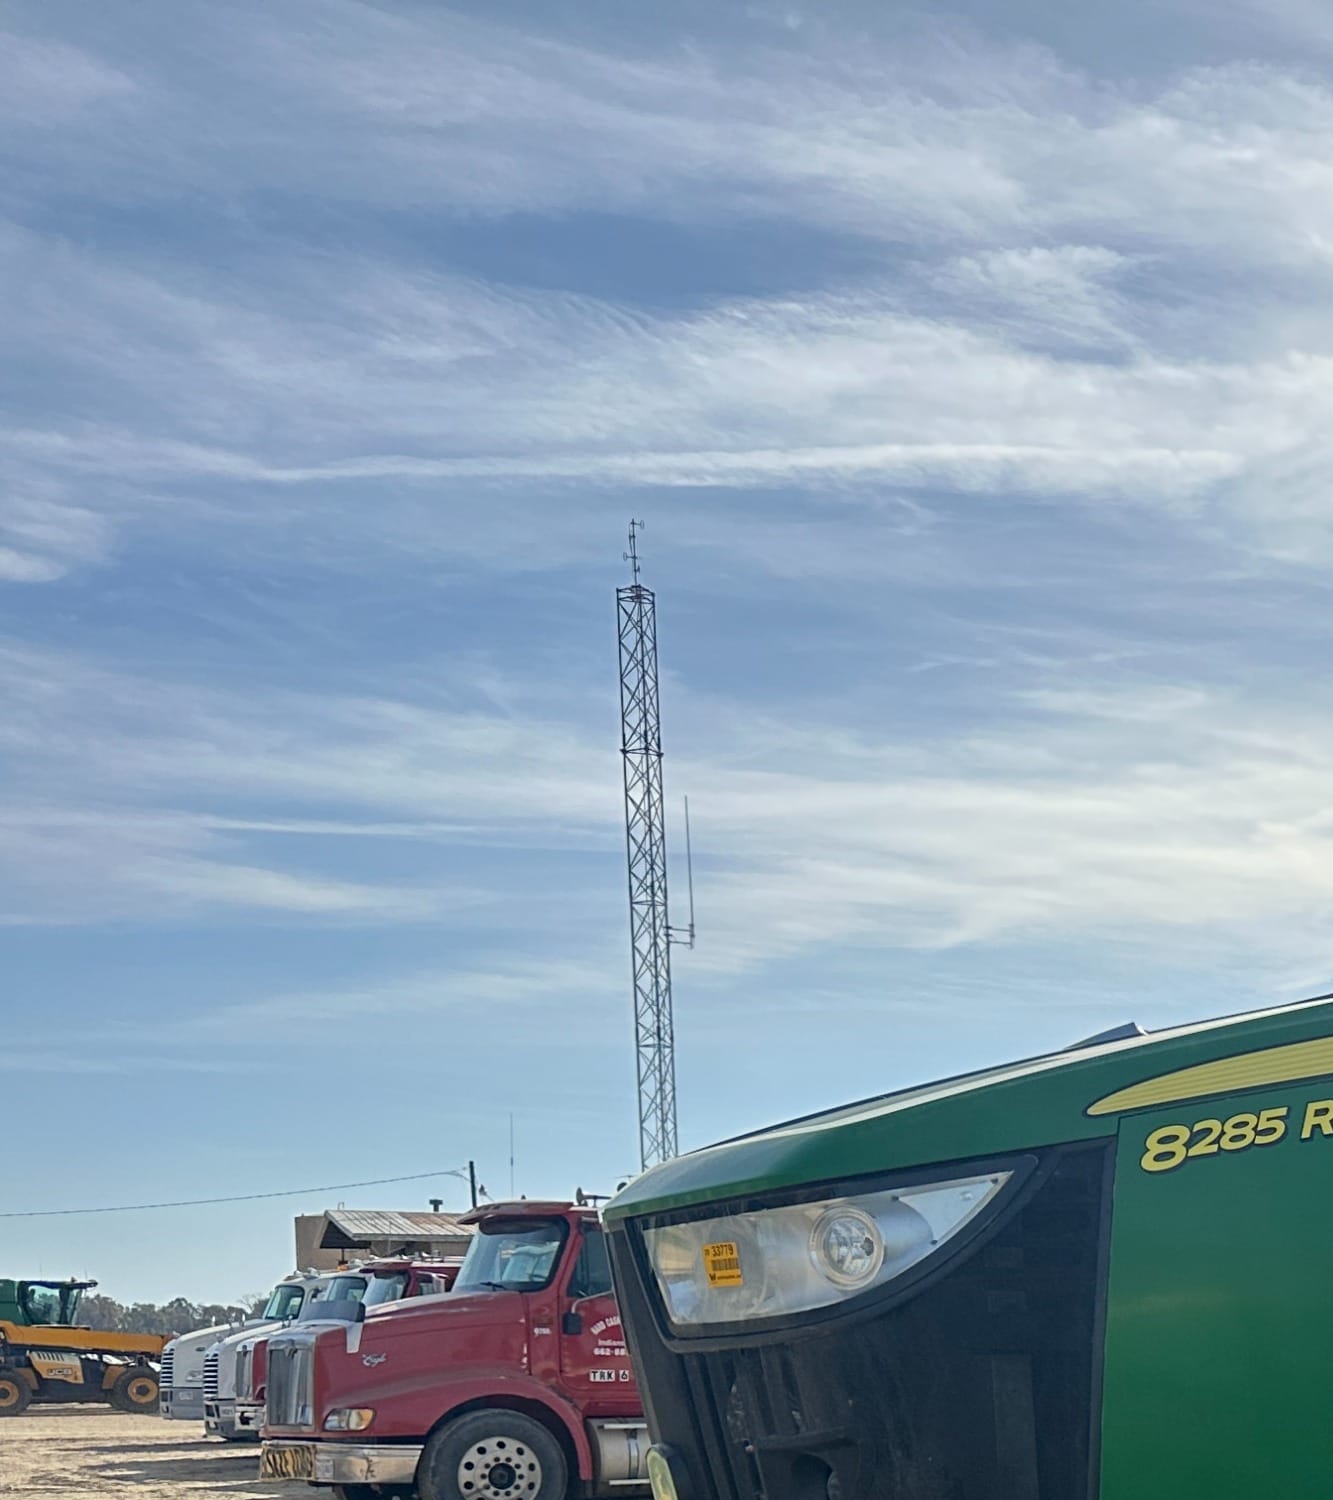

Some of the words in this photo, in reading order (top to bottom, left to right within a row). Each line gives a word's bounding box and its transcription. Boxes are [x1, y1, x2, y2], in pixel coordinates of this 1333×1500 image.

[1140, 1106, 1288, 1173] 8285
[591, 1371, 614, 1380] TRK
[620, 1371, 628, 1380] 6
